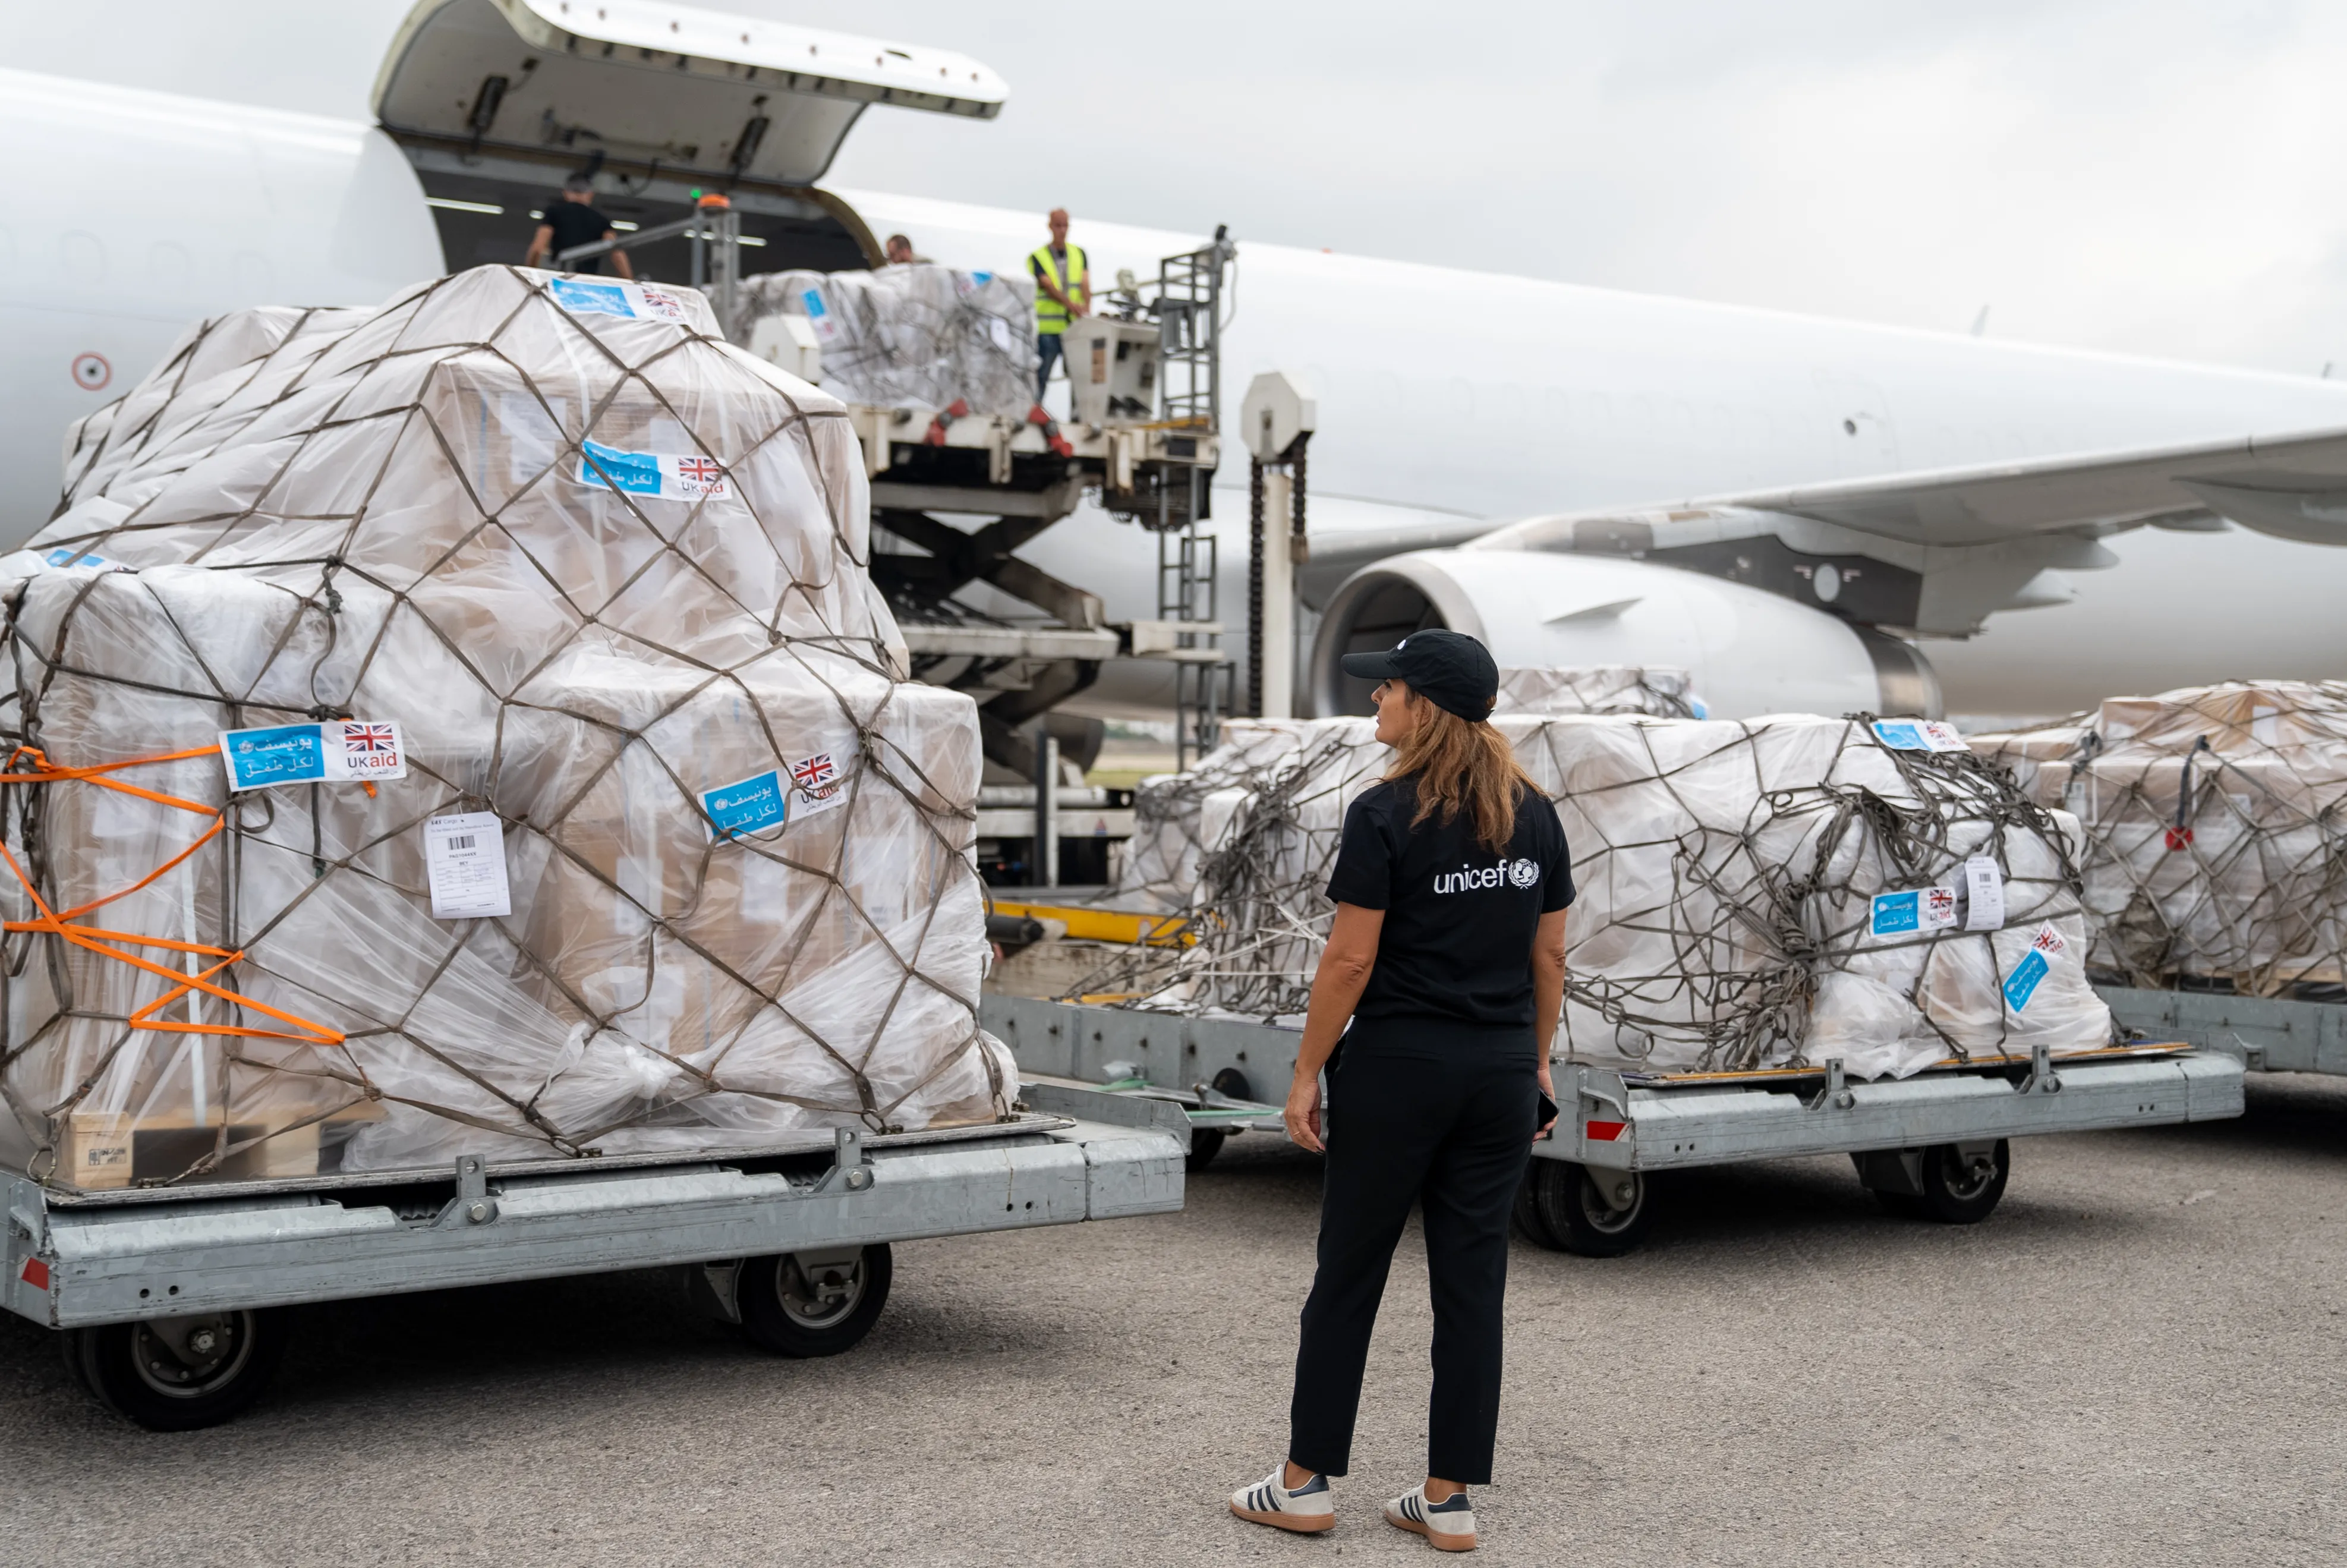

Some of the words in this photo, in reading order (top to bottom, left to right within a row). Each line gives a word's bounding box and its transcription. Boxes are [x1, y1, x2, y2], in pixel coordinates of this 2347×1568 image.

[628, 473, 653, 485] لكل
[254, 735, 313, 751] يونيسف
[287, 756, 314, 772] لكل
[348, 752, 397, 768] UKaid
[245, 760, 283, 778] طفل
[729, 785, 772, 807] يونيسف
[757, 803, 777, 821] لكل
[1434, 859, 1507, 893] unicef
[1901, 915, 1914, 925] لكل
